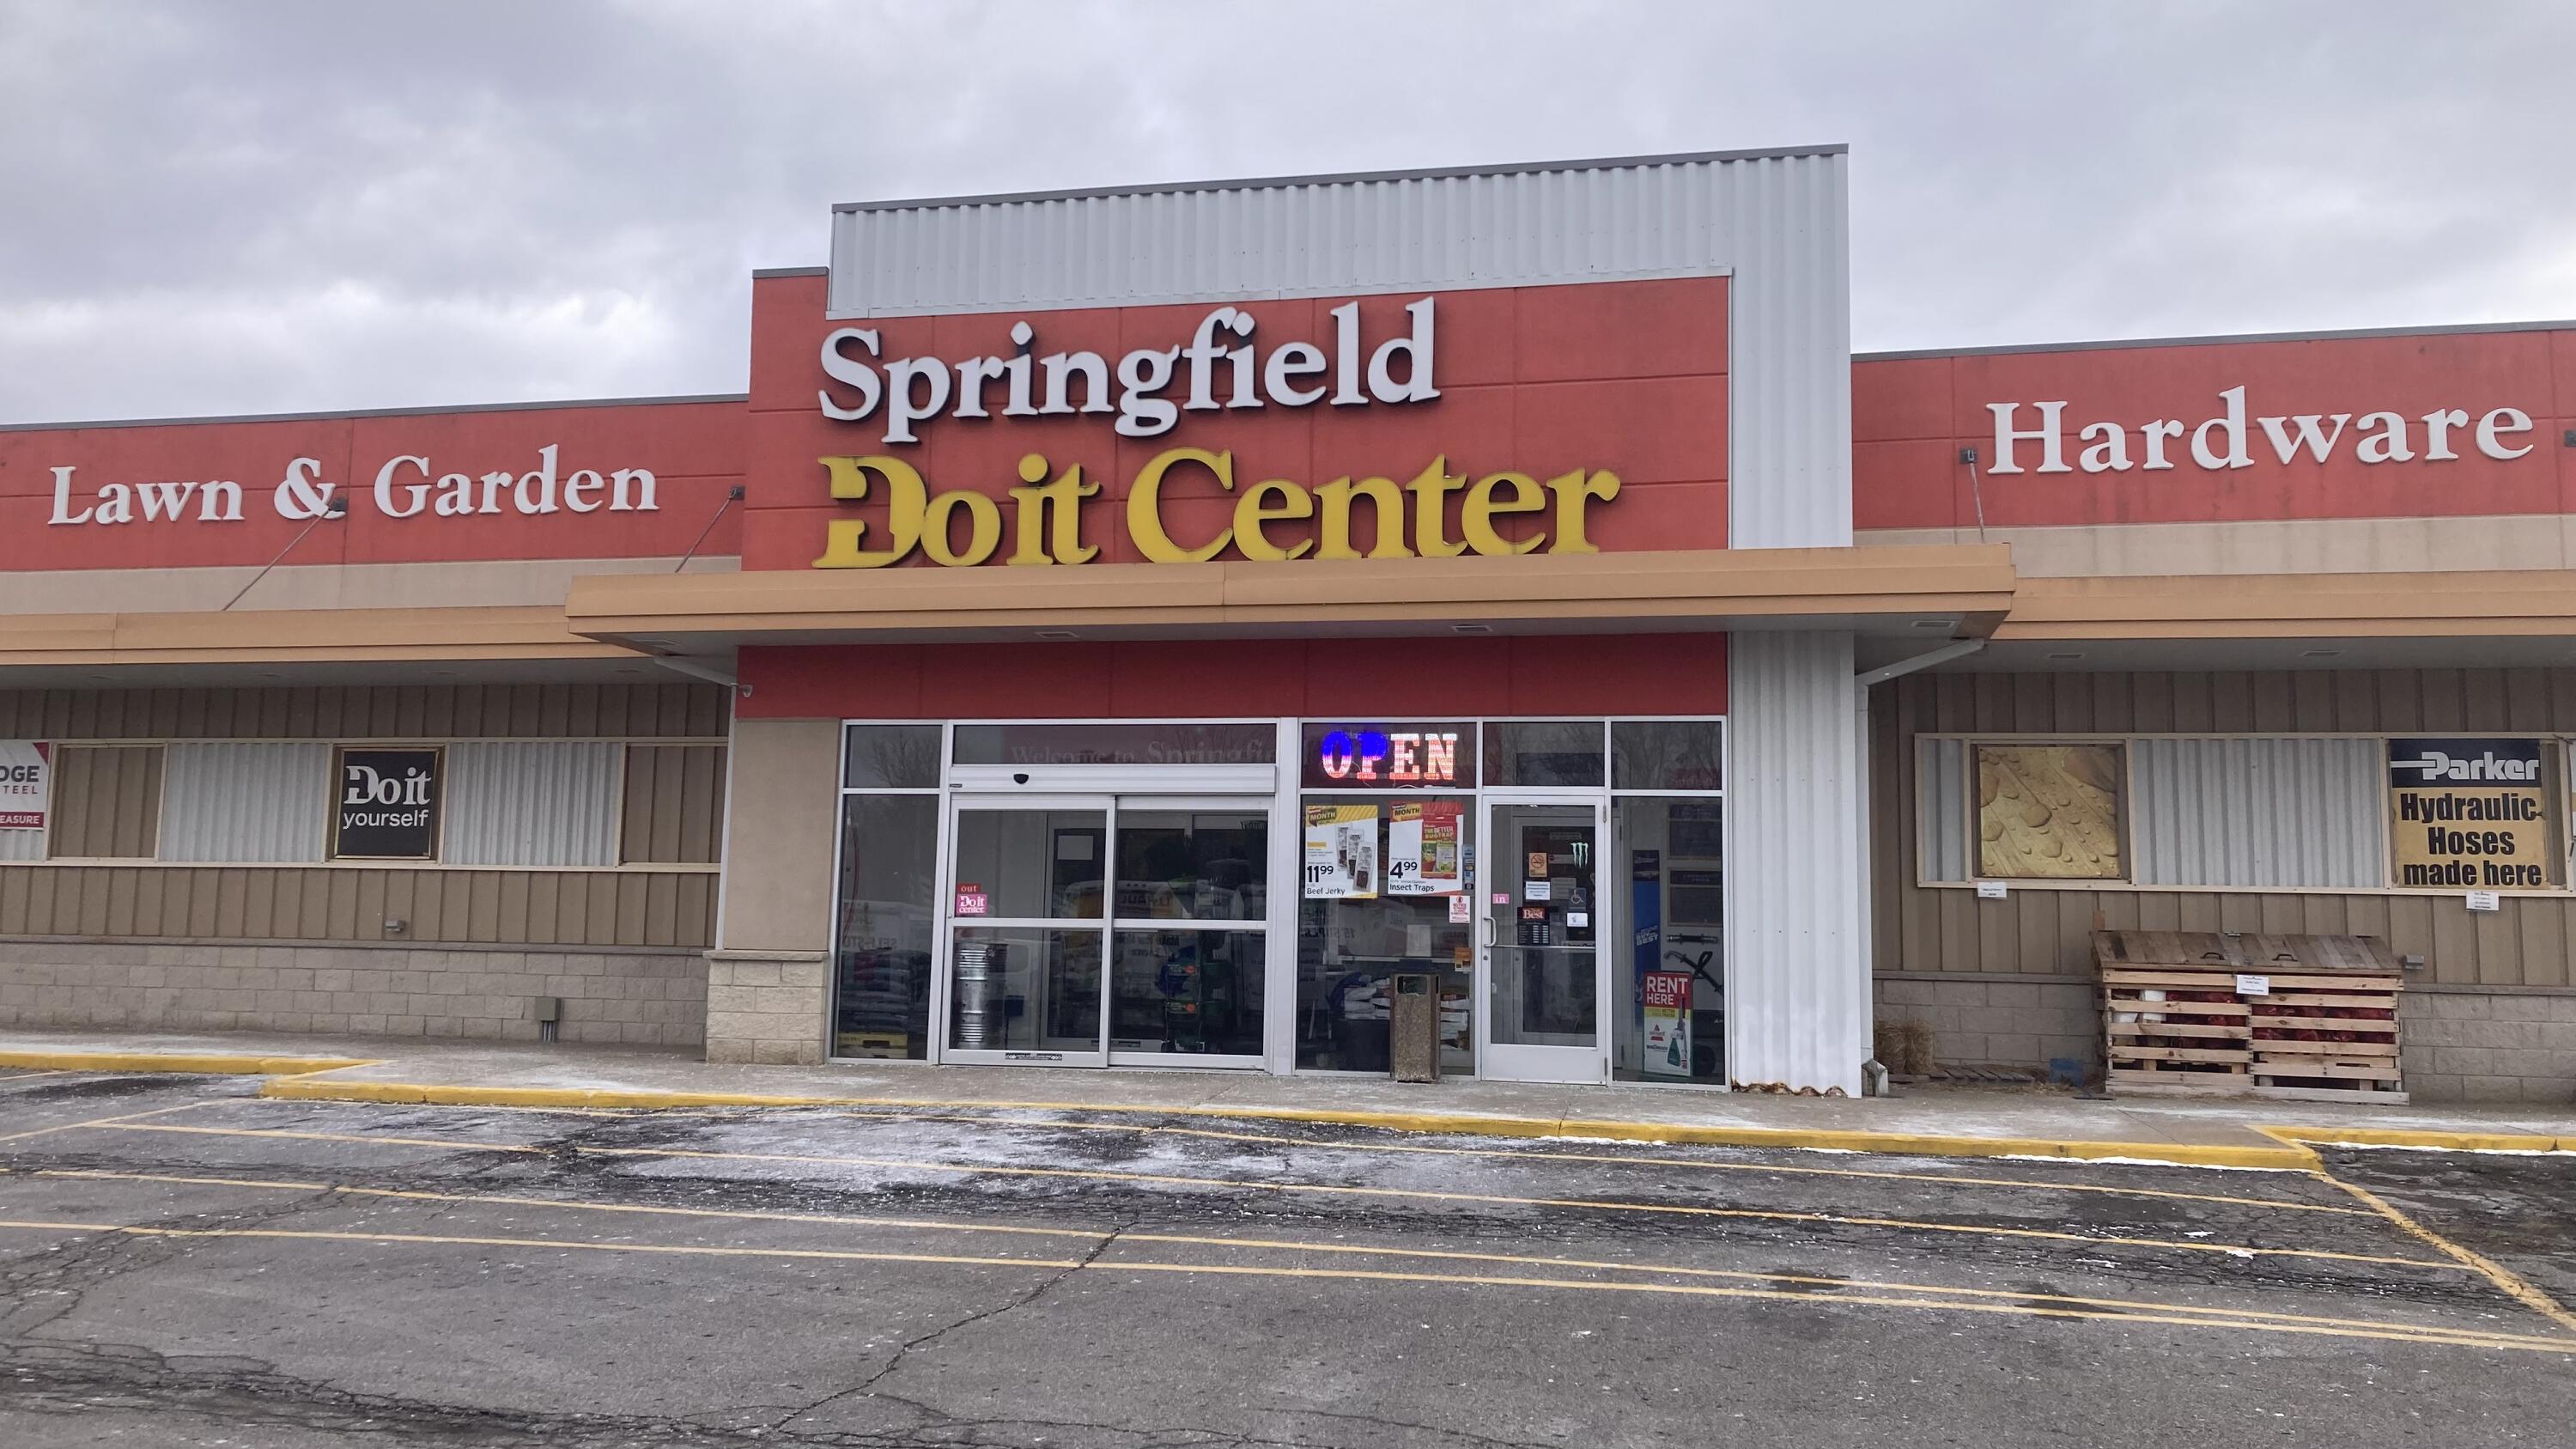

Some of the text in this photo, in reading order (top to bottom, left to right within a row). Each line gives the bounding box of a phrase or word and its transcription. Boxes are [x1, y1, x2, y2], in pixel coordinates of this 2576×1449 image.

[817, 295, 1442, 444] Springfield
[1985, 385, 2534, 474] Hardware
[47, 443, 660, 525] Lawn & Garden
[1126, 447, 1621, 563] Center
[1321, 730, 1458, 781] OPEN
[2421, 751, 2539, 780] Parker
[3, 785, 39, 795] TEEL
[1309, 812, 1336, 820] MONTH
[1394, 807, 1420, 816] MONTH
[2400, 792, 2537, 824] Hydraulic
[342, 809, 429, 830] yourself
[2427, 826, 2516, 855] Hoses
[2403, 860, 2543, 886] made here
[1325, 887, 1346, 896] Jerky
[1414, 884, 1435, 892] Traps
[1495, 894, 1506, 904] in
[1522, 909, 1544, 919] Best
[1646, 976, 1688, 995] RENT
[1646, 993, 1674, 1005] HERE
